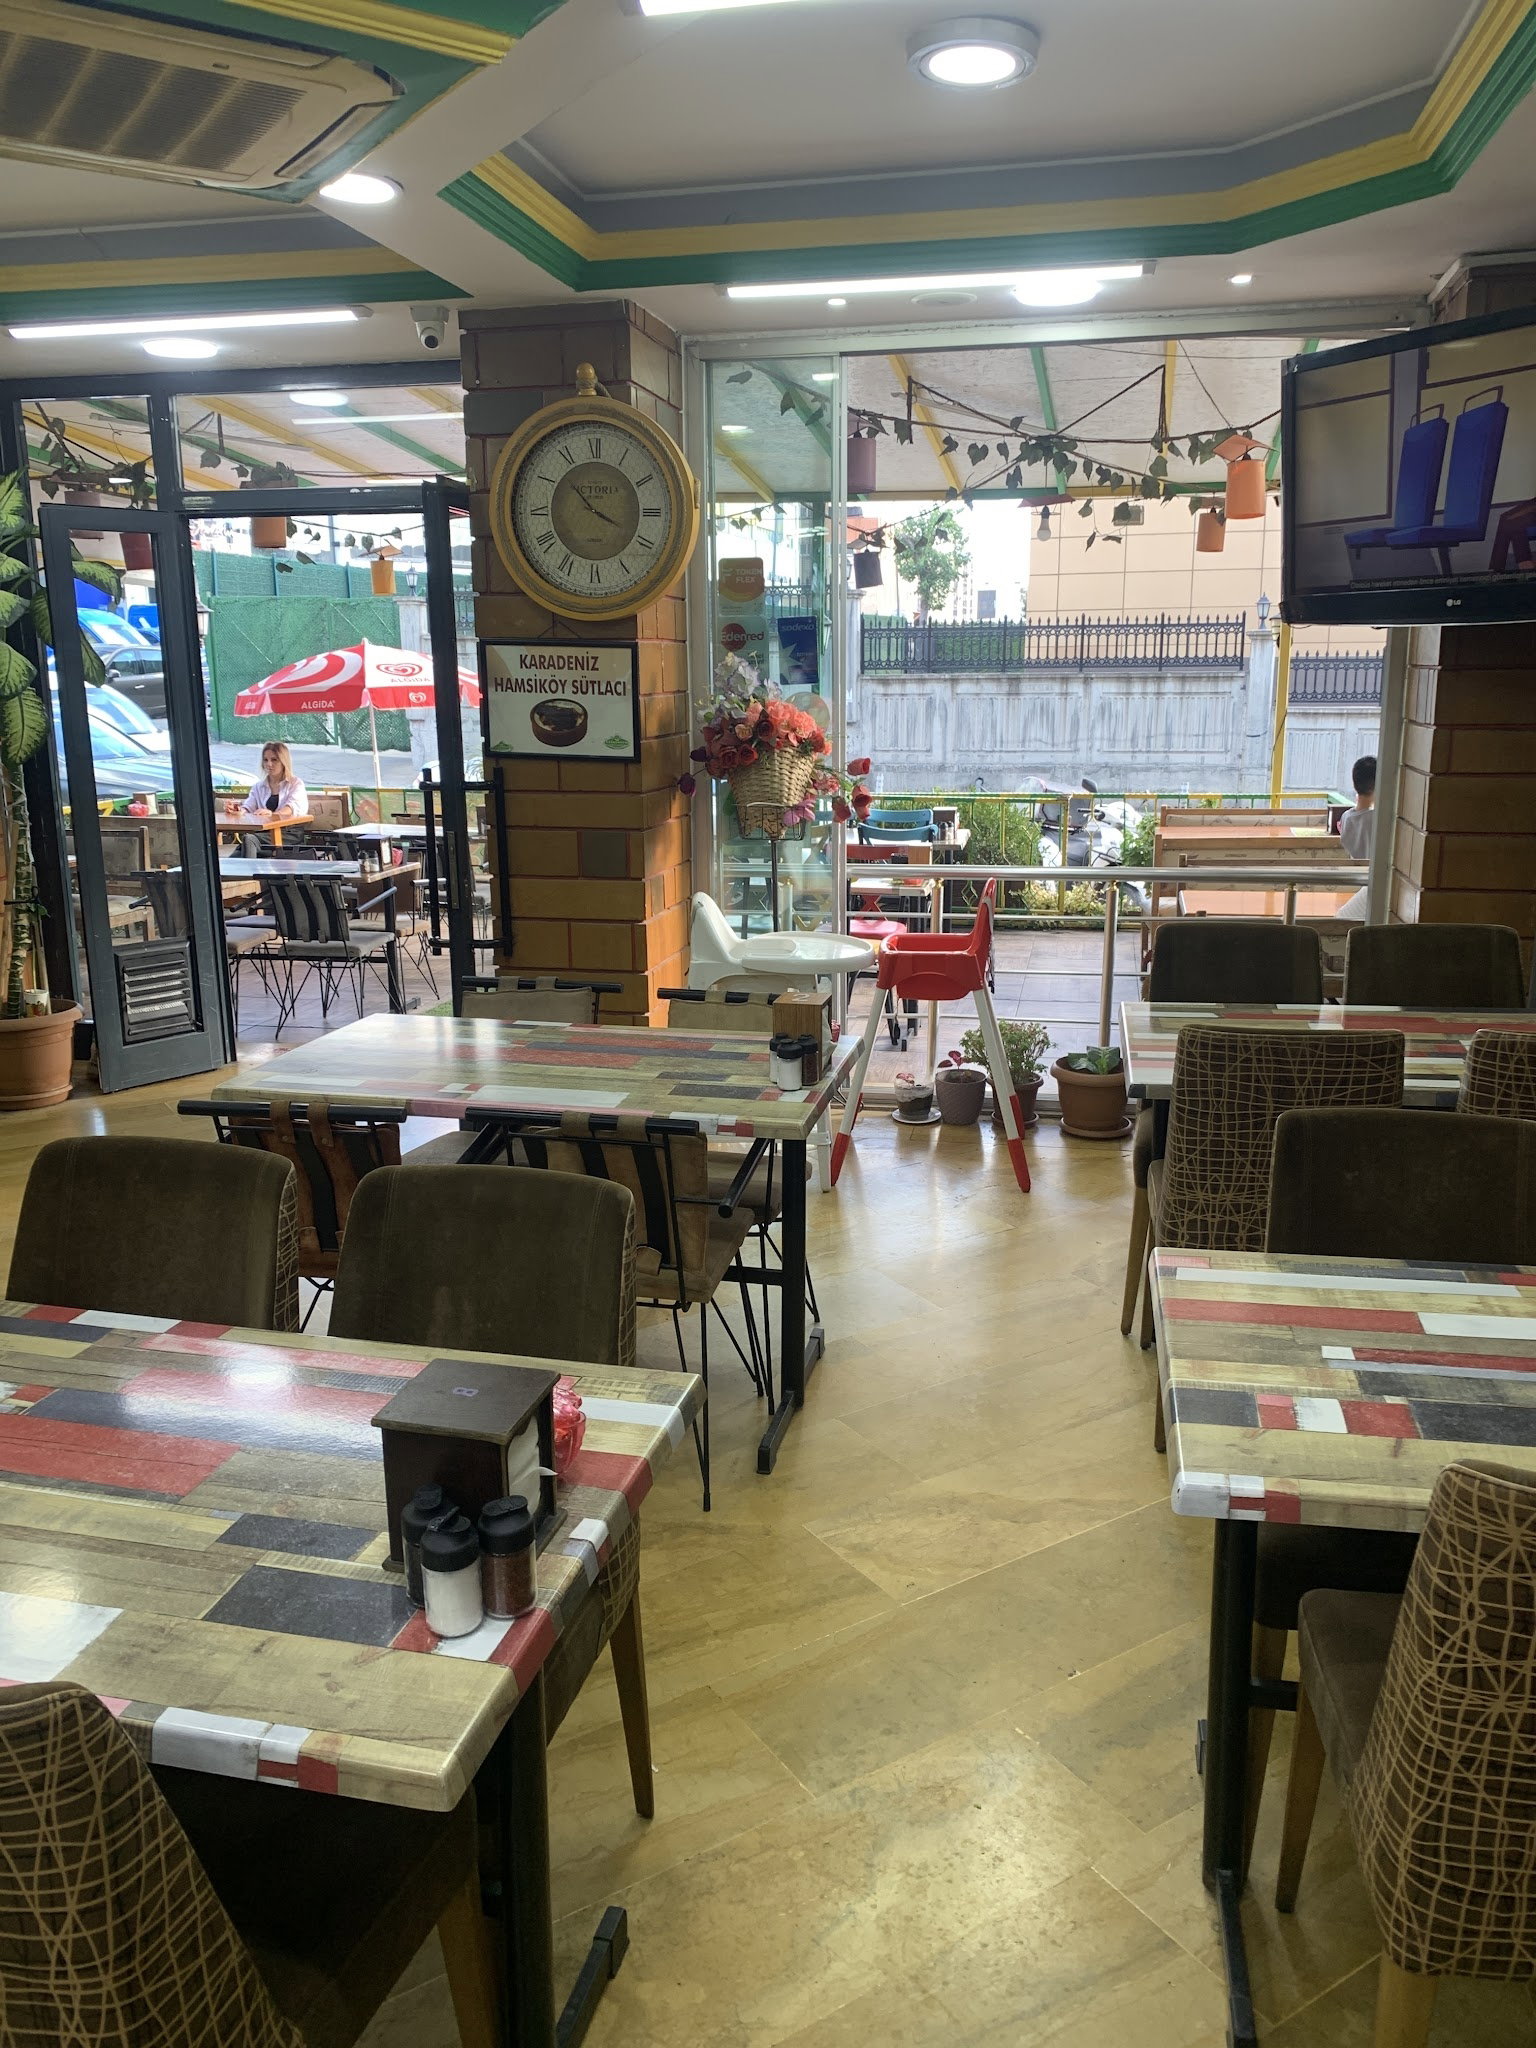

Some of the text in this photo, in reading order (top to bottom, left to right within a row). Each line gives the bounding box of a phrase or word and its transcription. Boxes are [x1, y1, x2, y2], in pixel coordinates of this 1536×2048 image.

[735, 568, 762, 576] TOKEN
[735, 576, 756, 584] FLEX
[781, 622, 814, 632] sodexo
[721, 631, 764, 642] Edenred
[519, 651, 600, 671] KARADENİZ
[494, 673, 627, 696] HAMSİKÖY SÜTLACI
